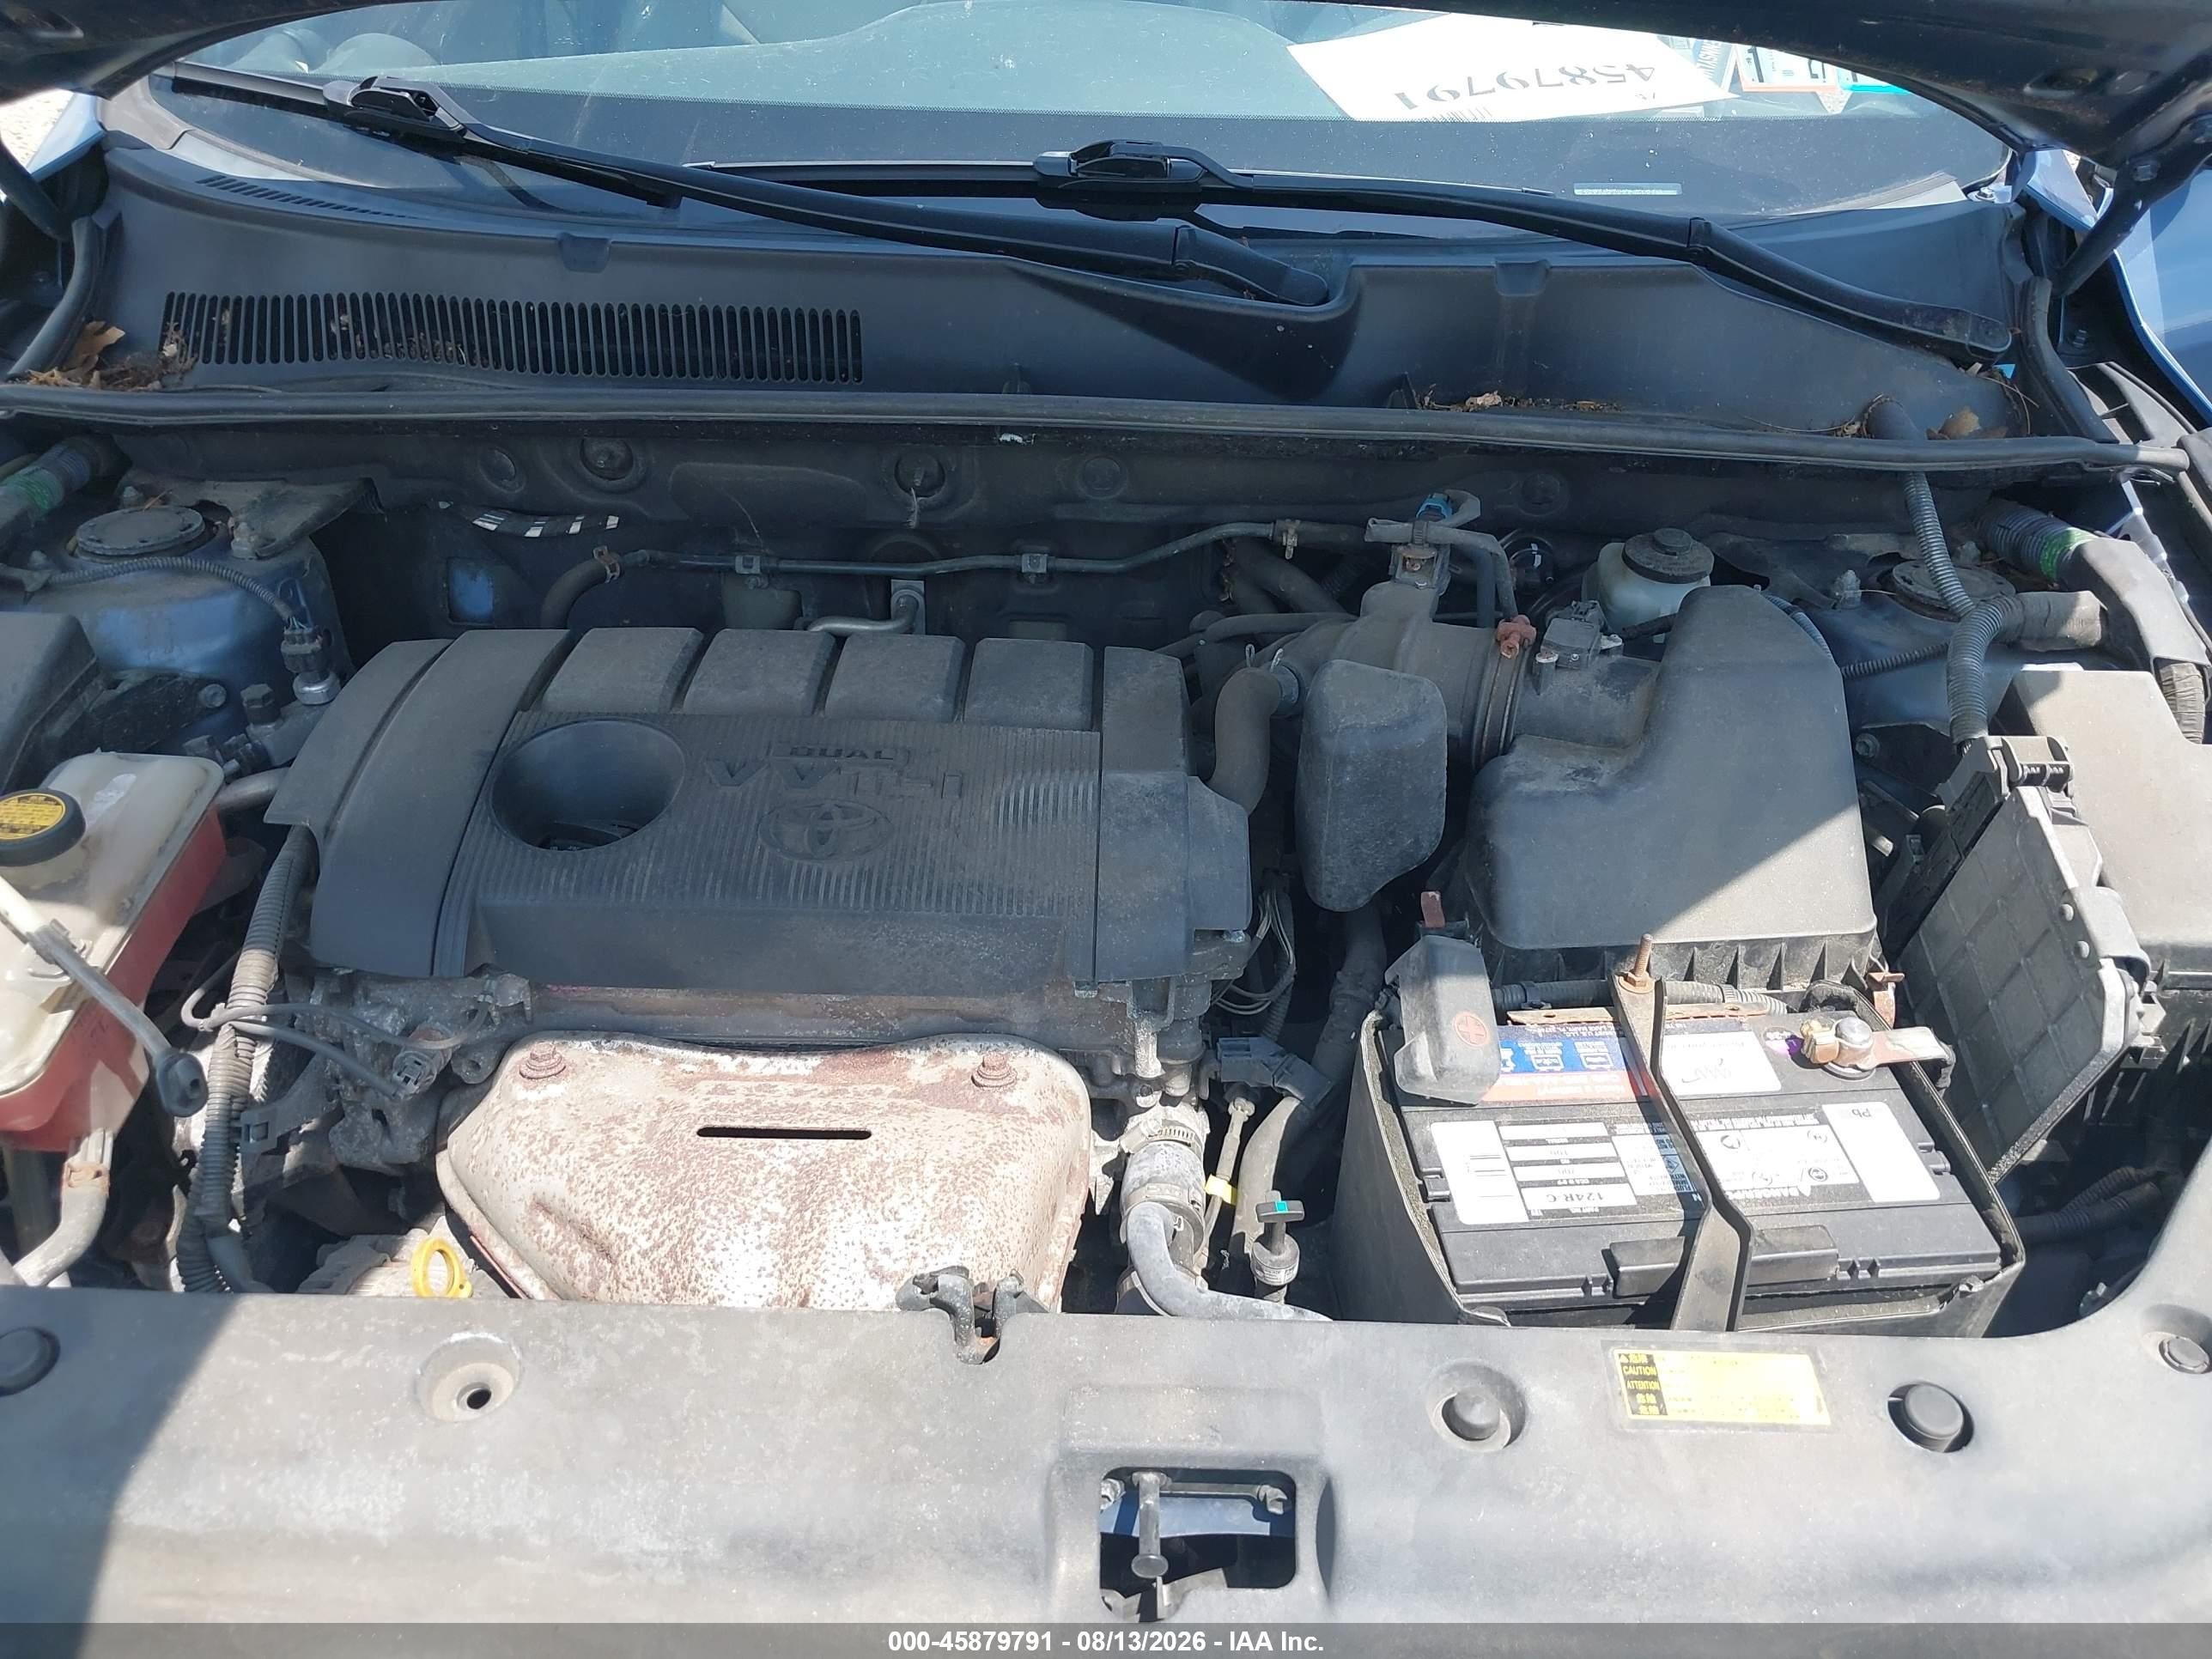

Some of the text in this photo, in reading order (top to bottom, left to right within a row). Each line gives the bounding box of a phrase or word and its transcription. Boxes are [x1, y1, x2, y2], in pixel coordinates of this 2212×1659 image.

[1394, 64, 1656, 111] 45879791
[1850, 1108, 1872, 1119] Pb
[1622, 1364, 1657, 1376] CAUTION
[1626, 1379, 1661, 1390] ATTENTION
